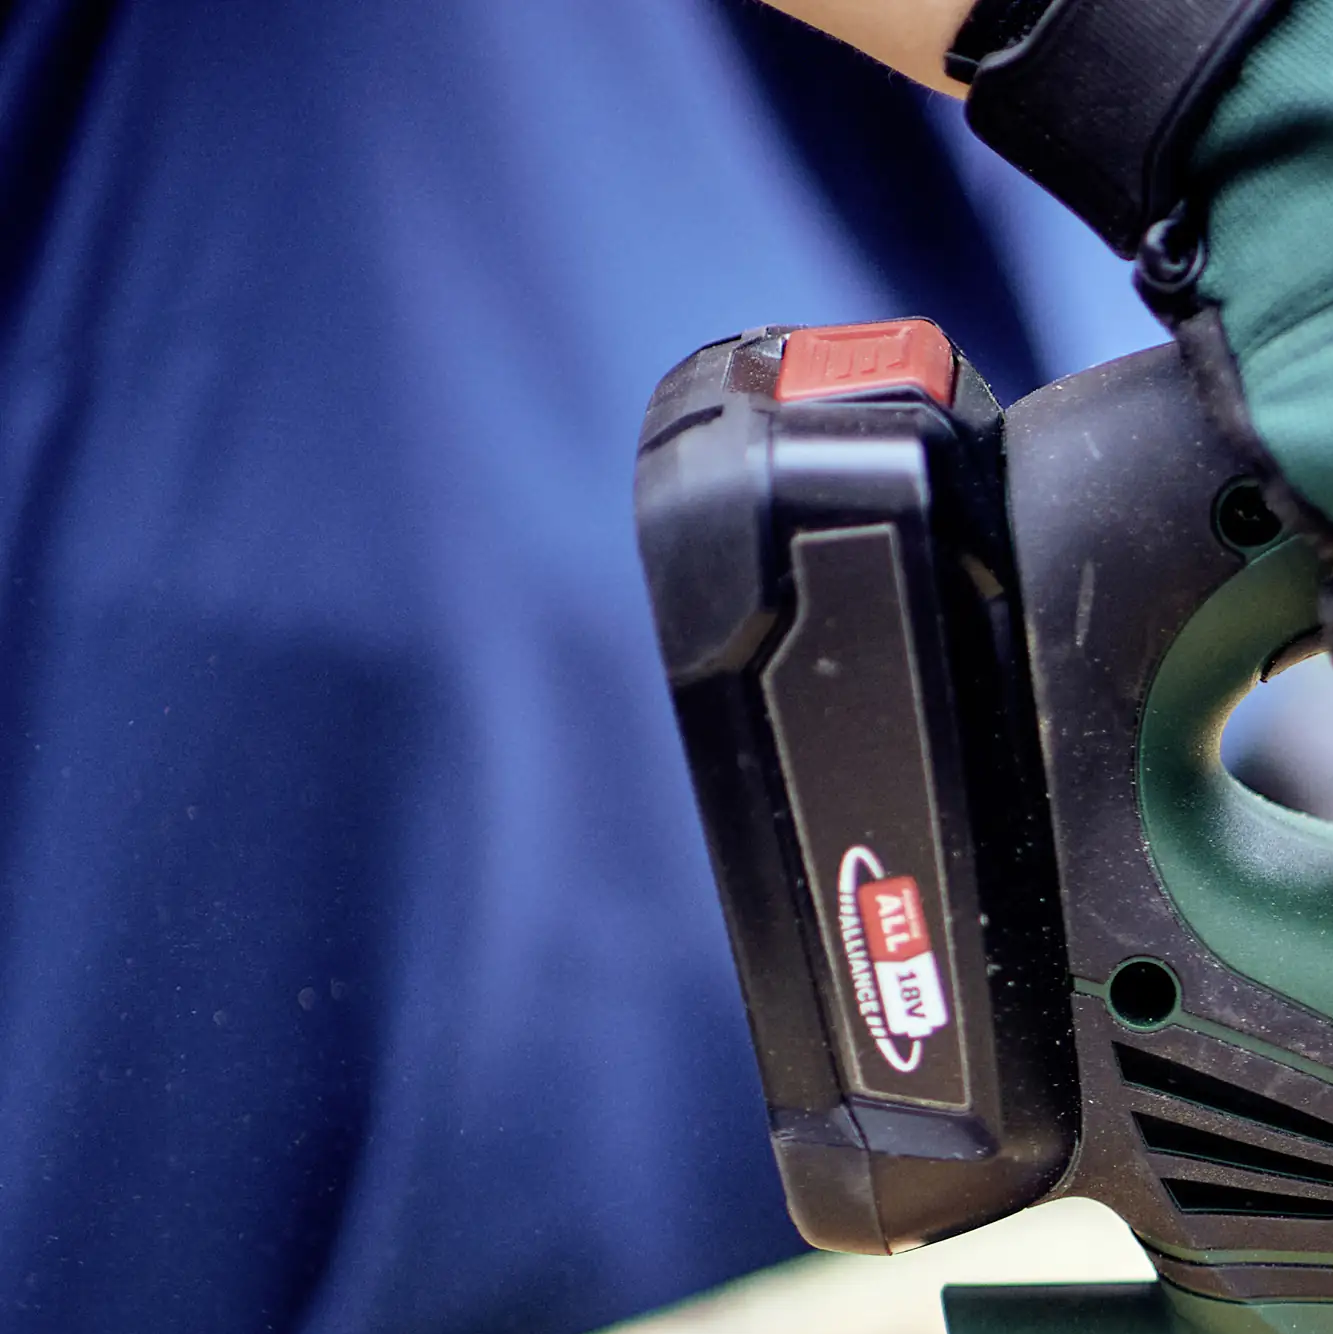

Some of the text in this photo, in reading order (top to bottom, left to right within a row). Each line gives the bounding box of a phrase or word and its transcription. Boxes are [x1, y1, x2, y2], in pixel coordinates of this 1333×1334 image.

[875, 894, 910, 953] ALL
[838, 915, 880, 1017] ALLIANCE
[896, 970, 927, 1020] 18V
